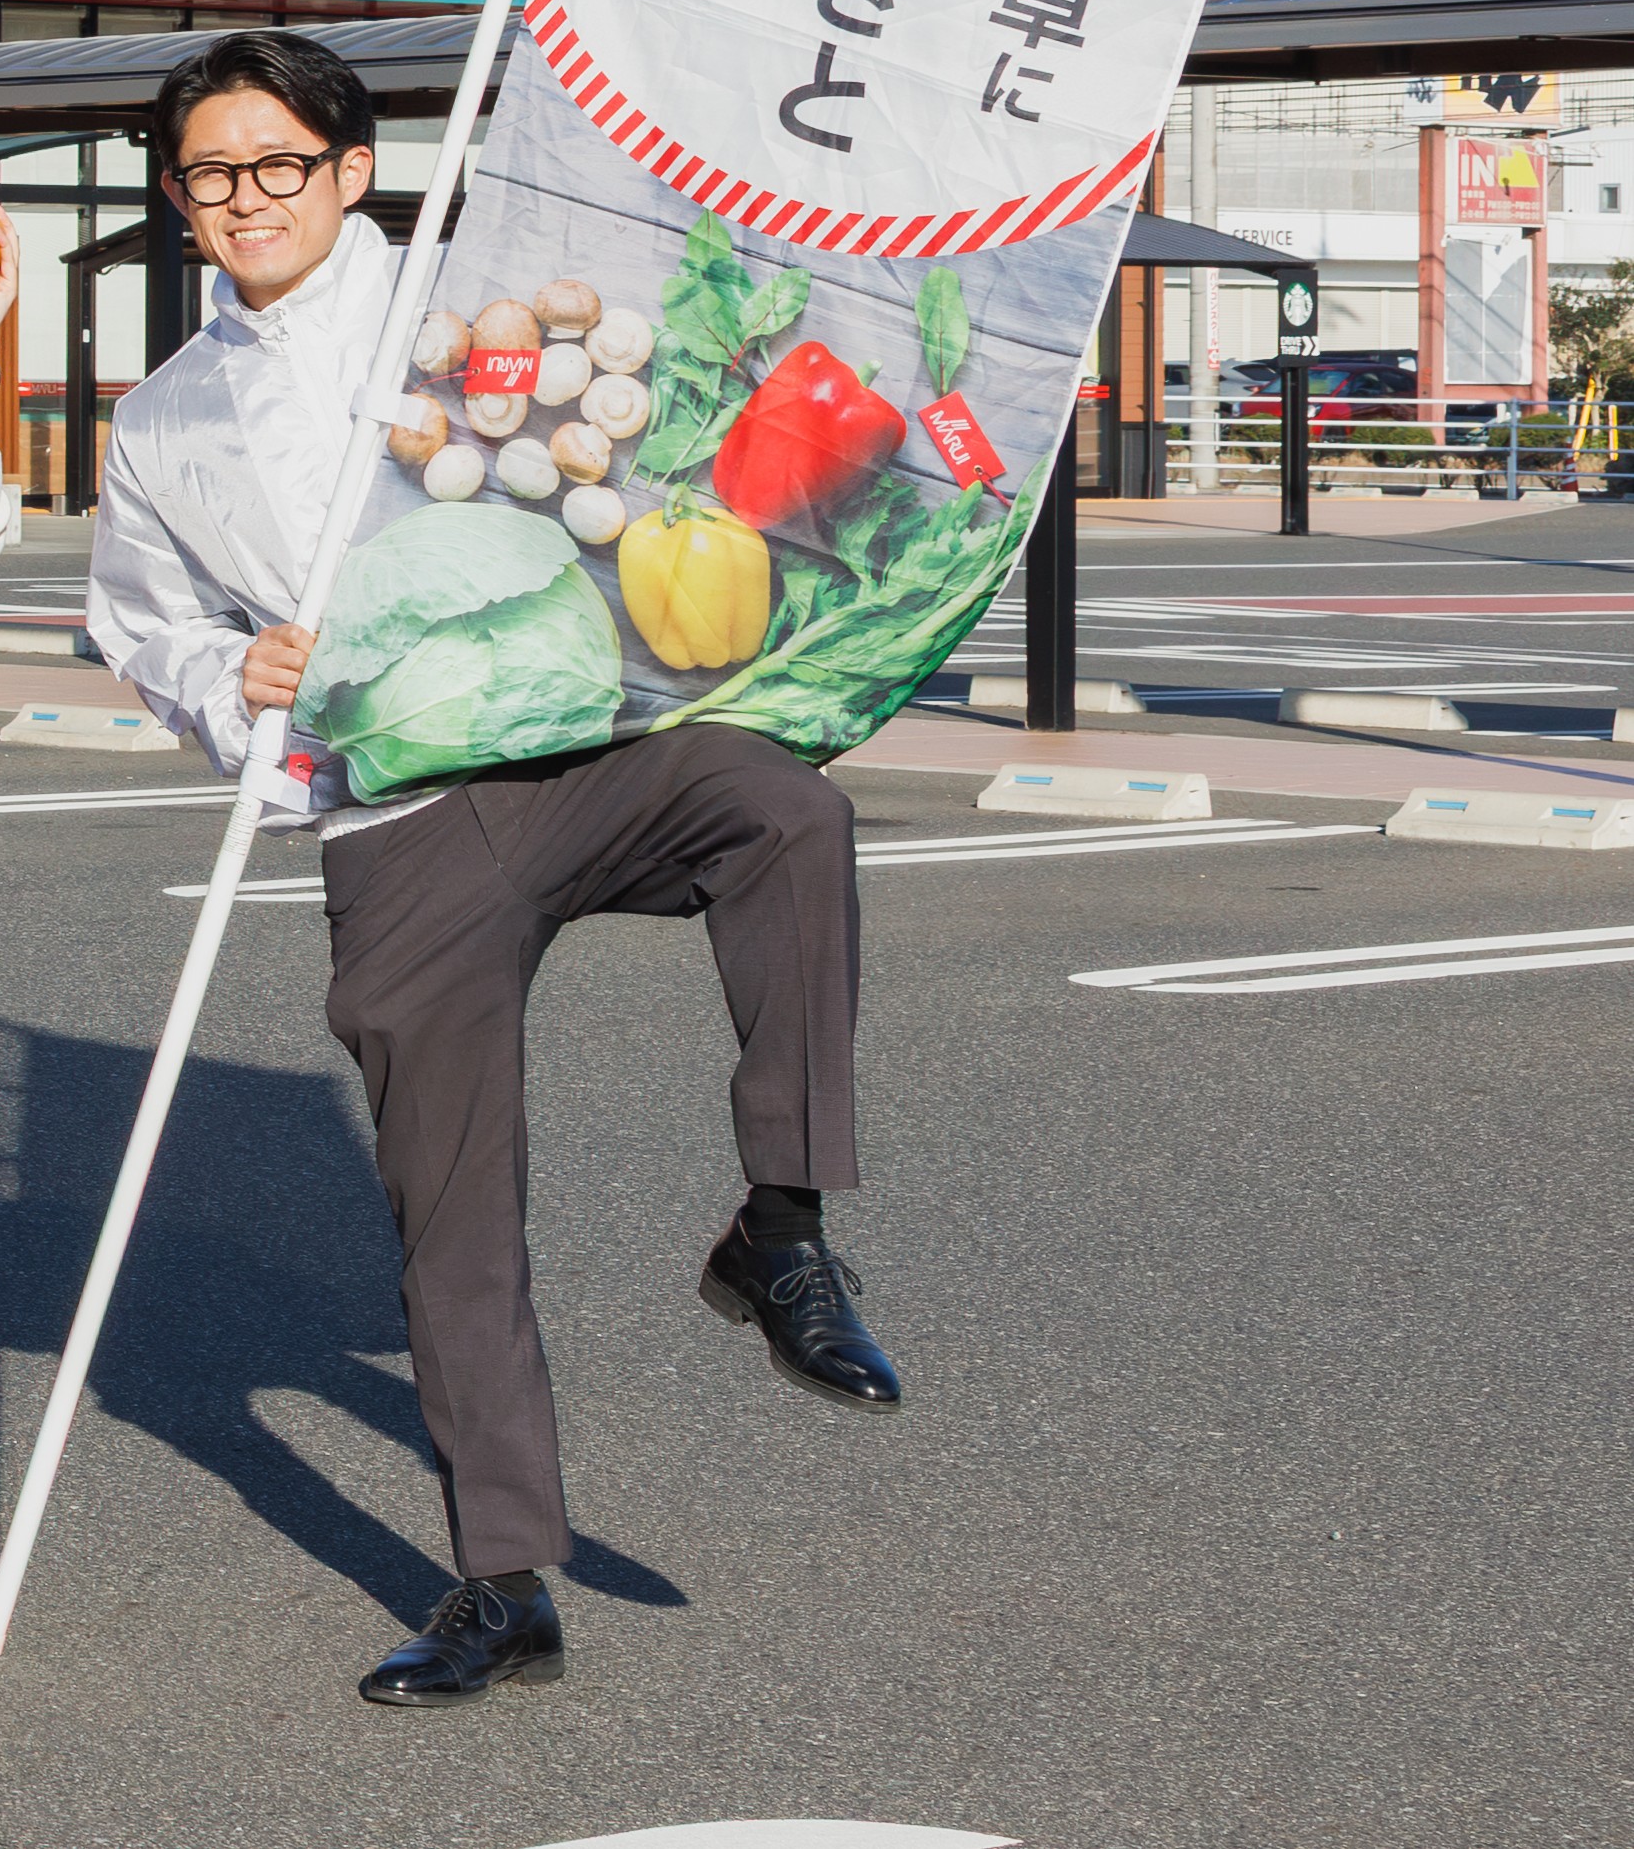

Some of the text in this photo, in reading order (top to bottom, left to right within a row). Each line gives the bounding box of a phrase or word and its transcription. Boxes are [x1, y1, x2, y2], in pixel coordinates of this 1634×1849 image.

[1461, 154, 1495, 187] IN
[1280, 335, 1302, 346] DRIVE
[486, 356, 534, 373] MARUI
[929, 409, 971, 465] MARUI
